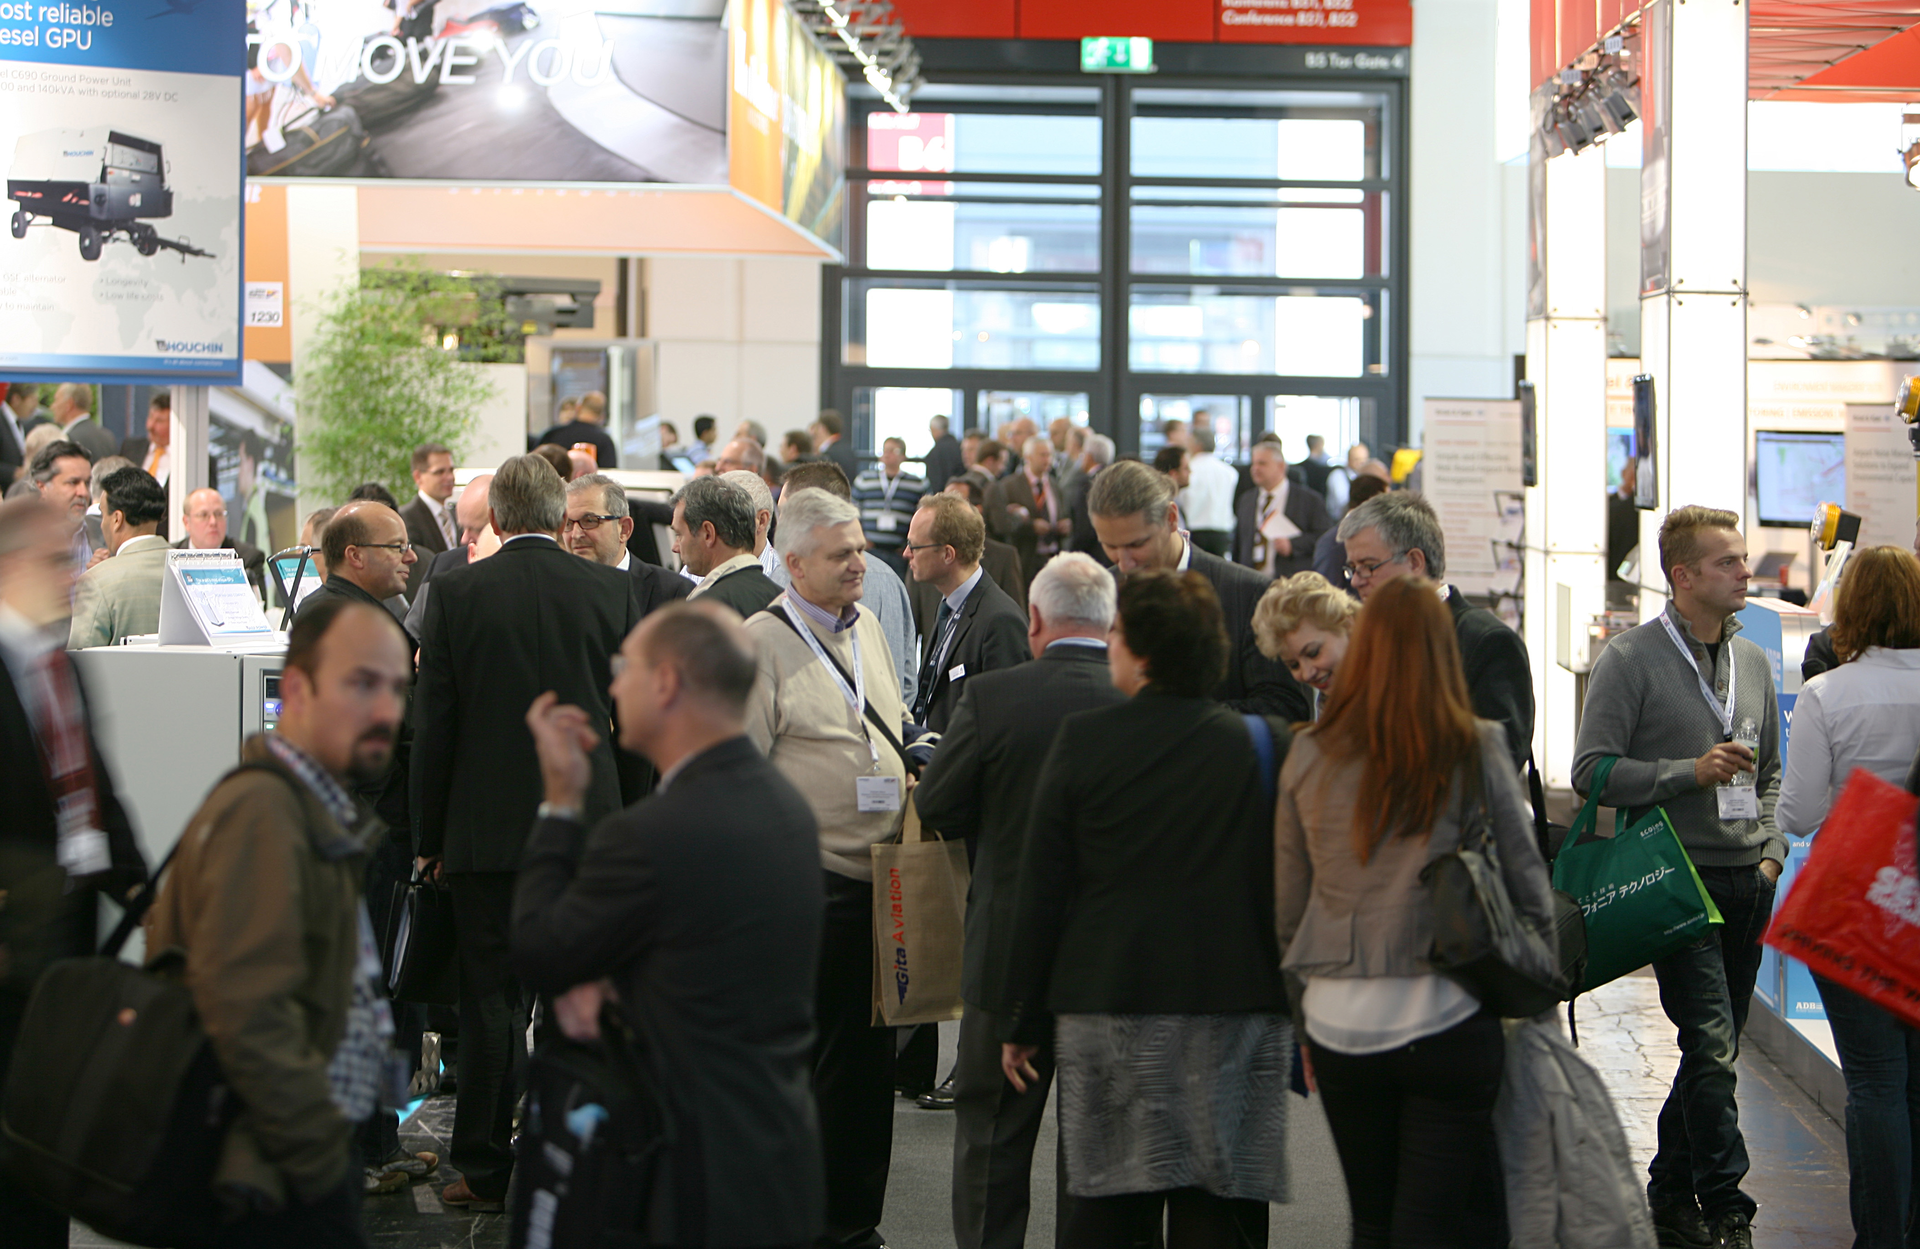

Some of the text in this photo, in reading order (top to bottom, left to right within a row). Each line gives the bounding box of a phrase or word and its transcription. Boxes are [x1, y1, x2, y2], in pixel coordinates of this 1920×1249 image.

[0, 1, 114, 27] ost reliable
[0, 26, 92, 50] esel GPU
[313, 35, 480, 85] MOVE
[494, 37, 615, 88] YOU
[1353, 52, 1391, 69] Gate
[11, 70, 38, 81] C690
[41, 71, 76, 83] Ground
[79, 74, 109, 86] Power
[112, 76, 131, 87] Unit
[18, 83, 36, 93] and
[38, 83, 75, 95] 140kVA
[78, 86, 99, 97] with
[101, 88, 140, 101] optional
[164, 92, 179, 102] DC
[105, 276, 149, 289] Longevity
[105, 291, 123, 301] Low
[17, 303, 55, 312] maintain
[250, 311, 280, 323] 1230
[168, 341, 223, 353] HOUCHIN
[1619, 866, 1675, 900] テクノロジー
[889, 867, 909, 1001] Gita Aviation
[1796, 1001, 1816, 1010] ADB
